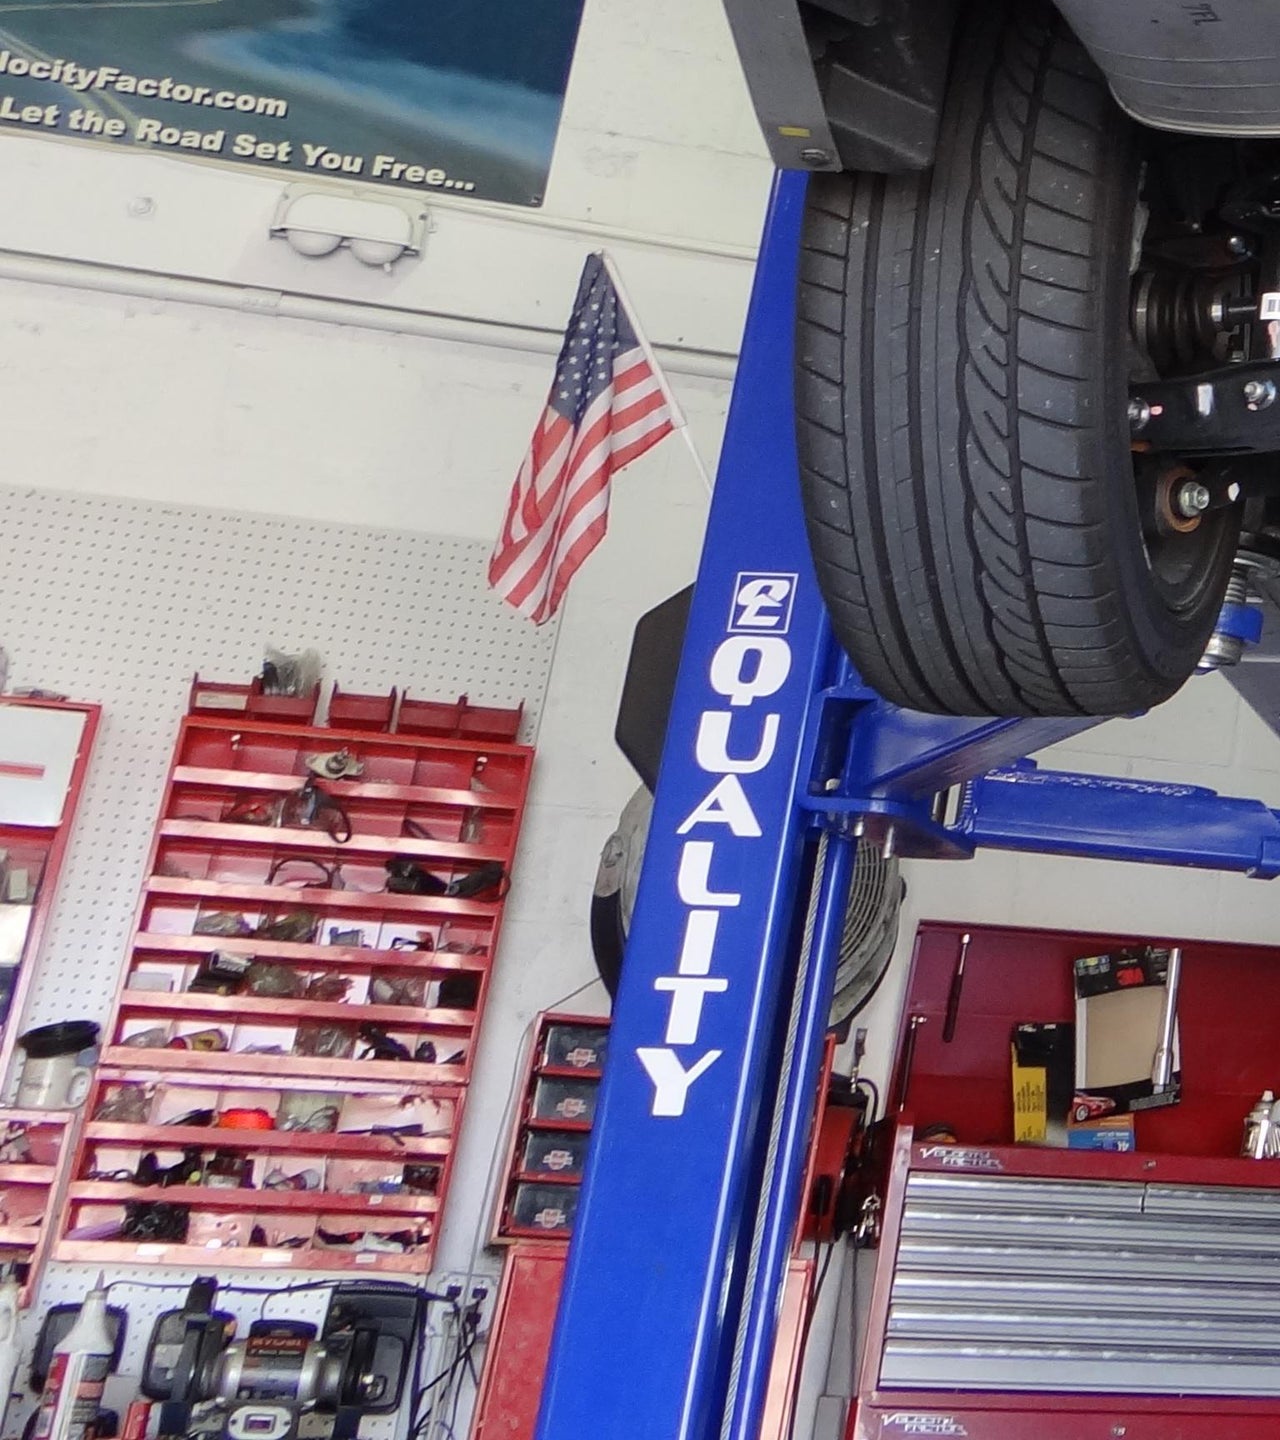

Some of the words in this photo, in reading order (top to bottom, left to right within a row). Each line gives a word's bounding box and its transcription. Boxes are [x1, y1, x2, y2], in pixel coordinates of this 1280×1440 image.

[0, 96, 61, 127] Let
[68, 107, 128, 138] the
[135, 117, 226, 153] Road
[232, 132, 293, 163] Set
[302, 143, 364, 175] You
[371, 154, 476, 192] Free...
[635, 635, 793, 1117] QUALITY
